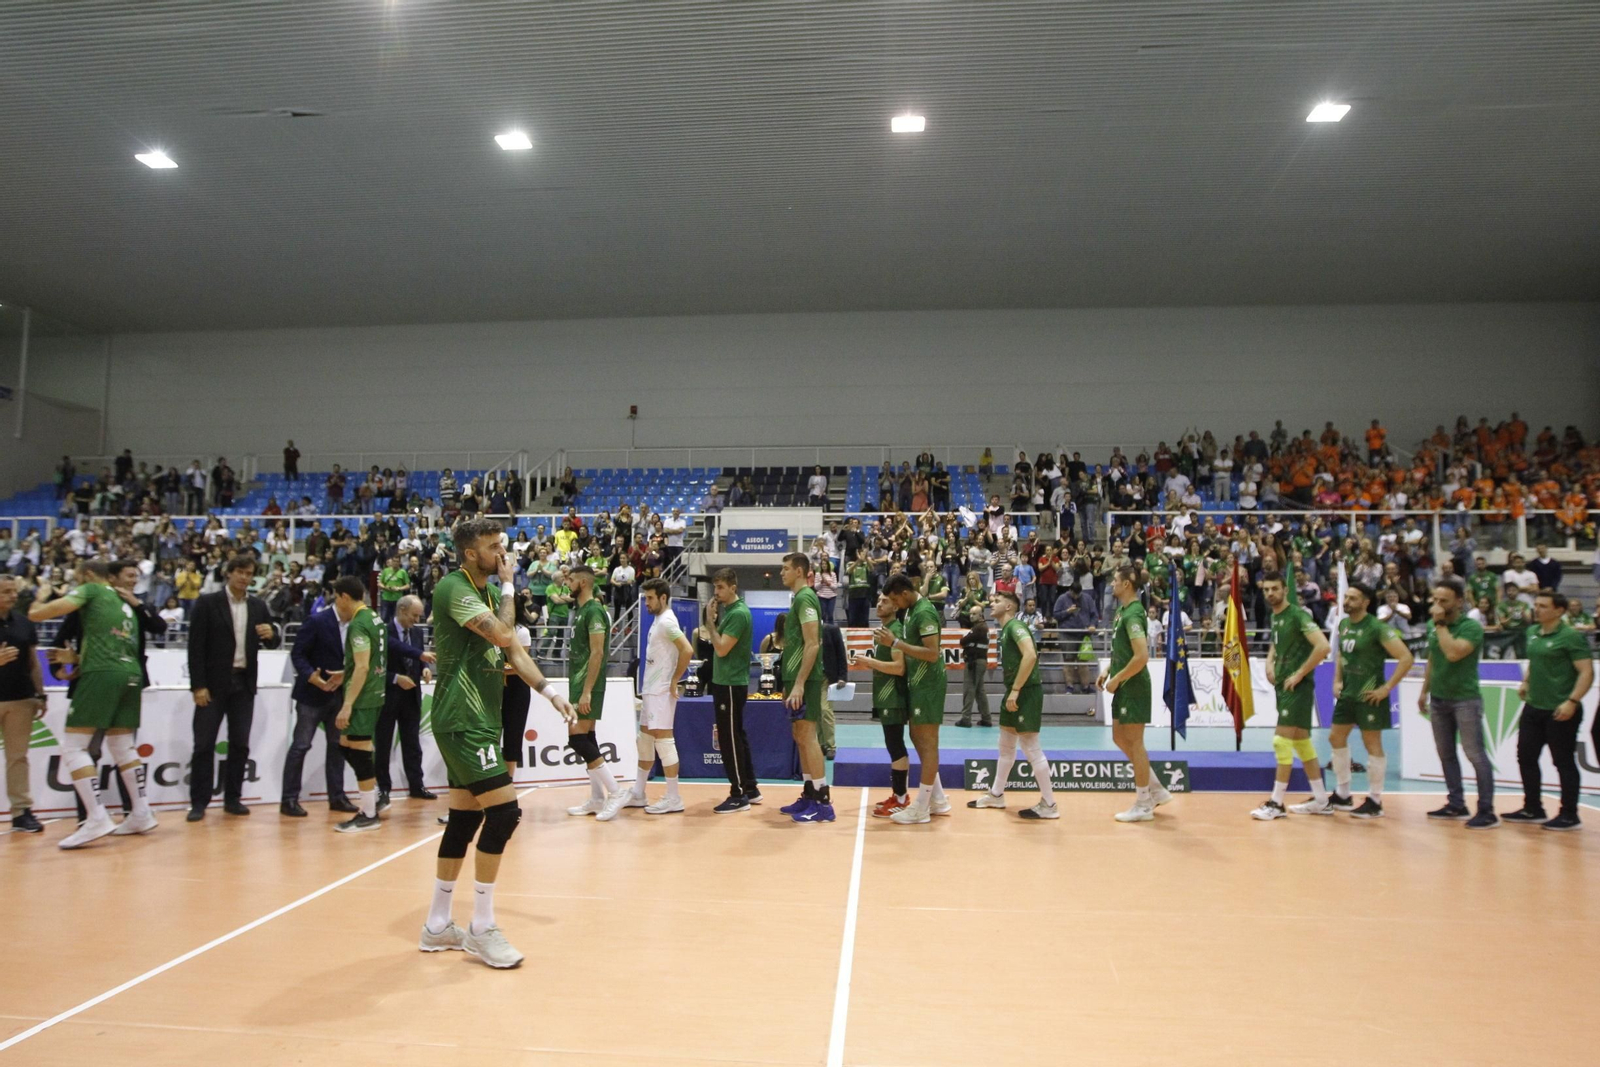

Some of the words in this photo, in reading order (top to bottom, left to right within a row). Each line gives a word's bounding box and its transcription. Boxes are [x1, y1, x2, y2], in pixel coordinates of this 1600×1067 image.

[1342, 639, 1356, 653] 10
[476, 744, 497, 766] 14
[1017, 762, 1136, 779] CMPEONES
[1080, 782, 1116, 790] VOLEIBOL
